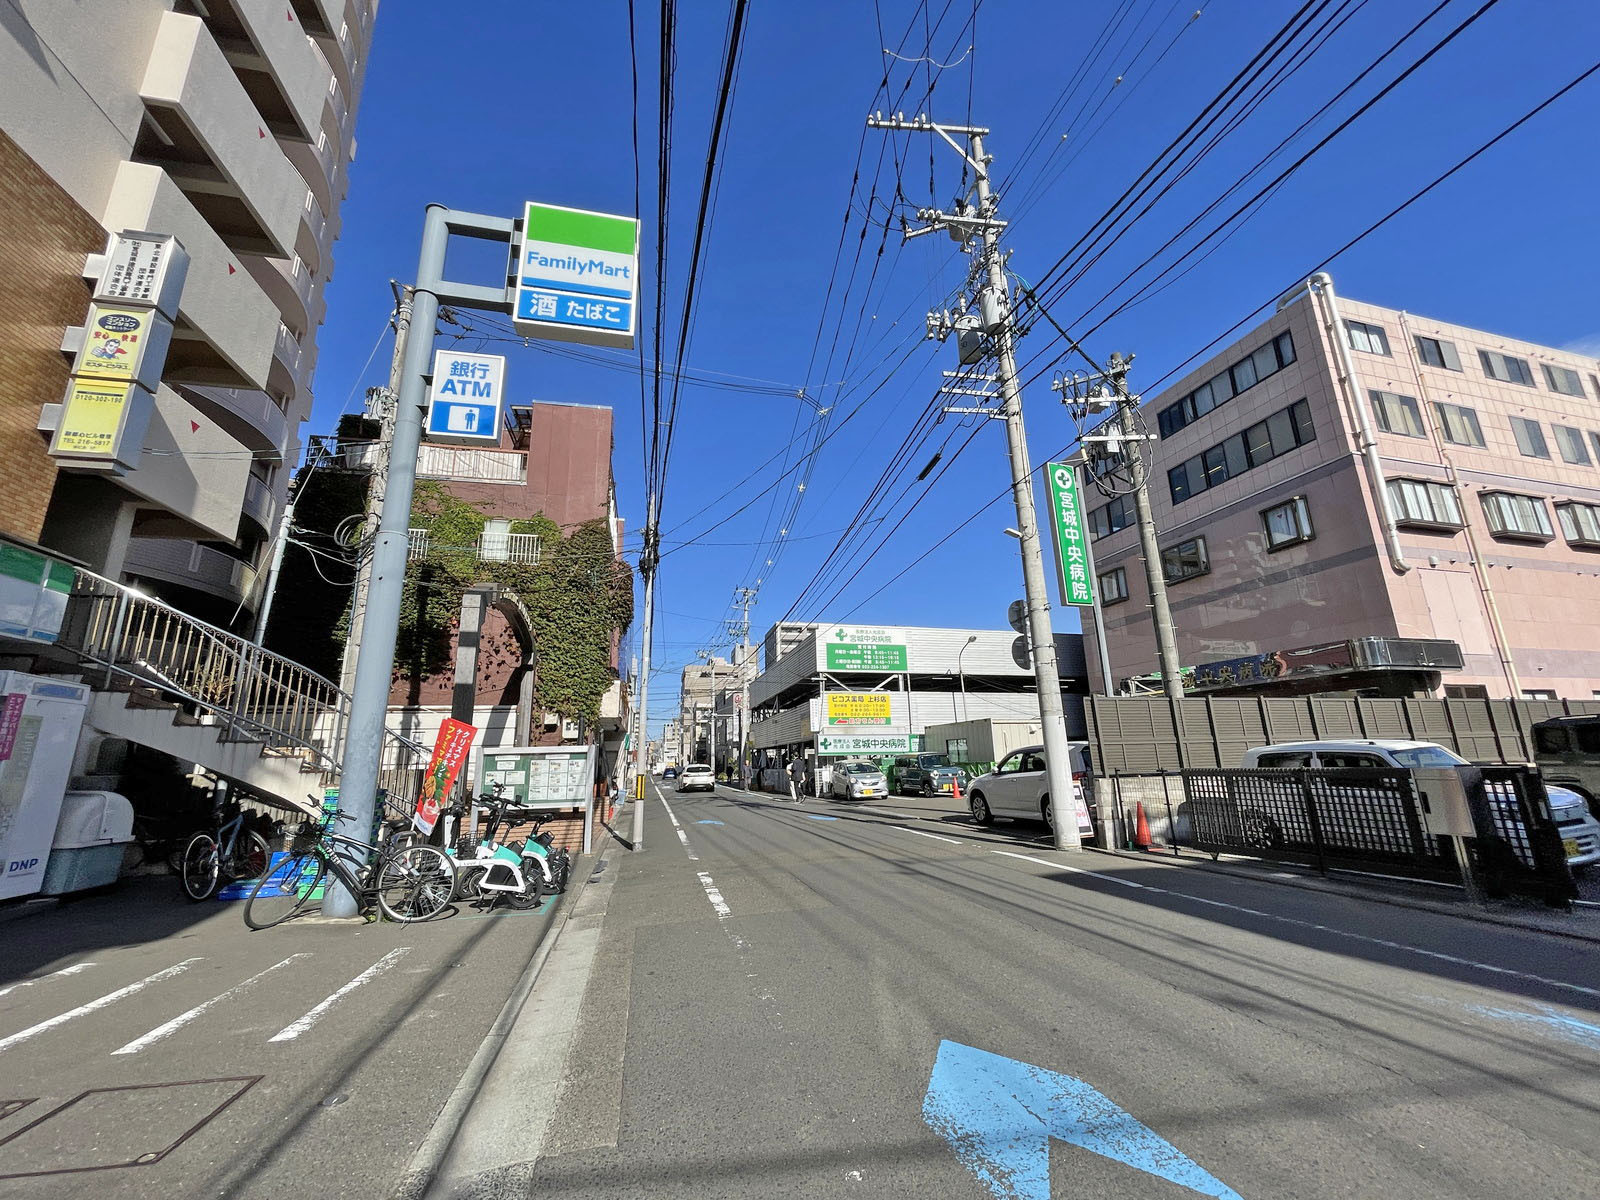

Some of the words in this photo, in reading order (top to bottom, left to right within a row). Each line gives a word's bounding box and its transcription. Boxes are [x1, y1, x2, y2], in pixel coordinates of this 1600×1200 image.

[526, 251, 630, 279] FamilyMart
[529, 293, 559, 318] 酒
[566, 300, 620, 323] たばこ
[93, 331, 110, 340] 安心
[449, 360, 490, 380] 銀行
[440, 378, 492, 398] ATM
[1058, 491, 1089, 601] 宮城中央病院
[849, 634, 892, 644] 宮城中央病院
[867, 695, 887, 703] 上杉店
[449, 730, 470, 768] クリスマス
[852, 738, 907, 749] 宮城中央病院
[9, 858, 39, 872] DNP
